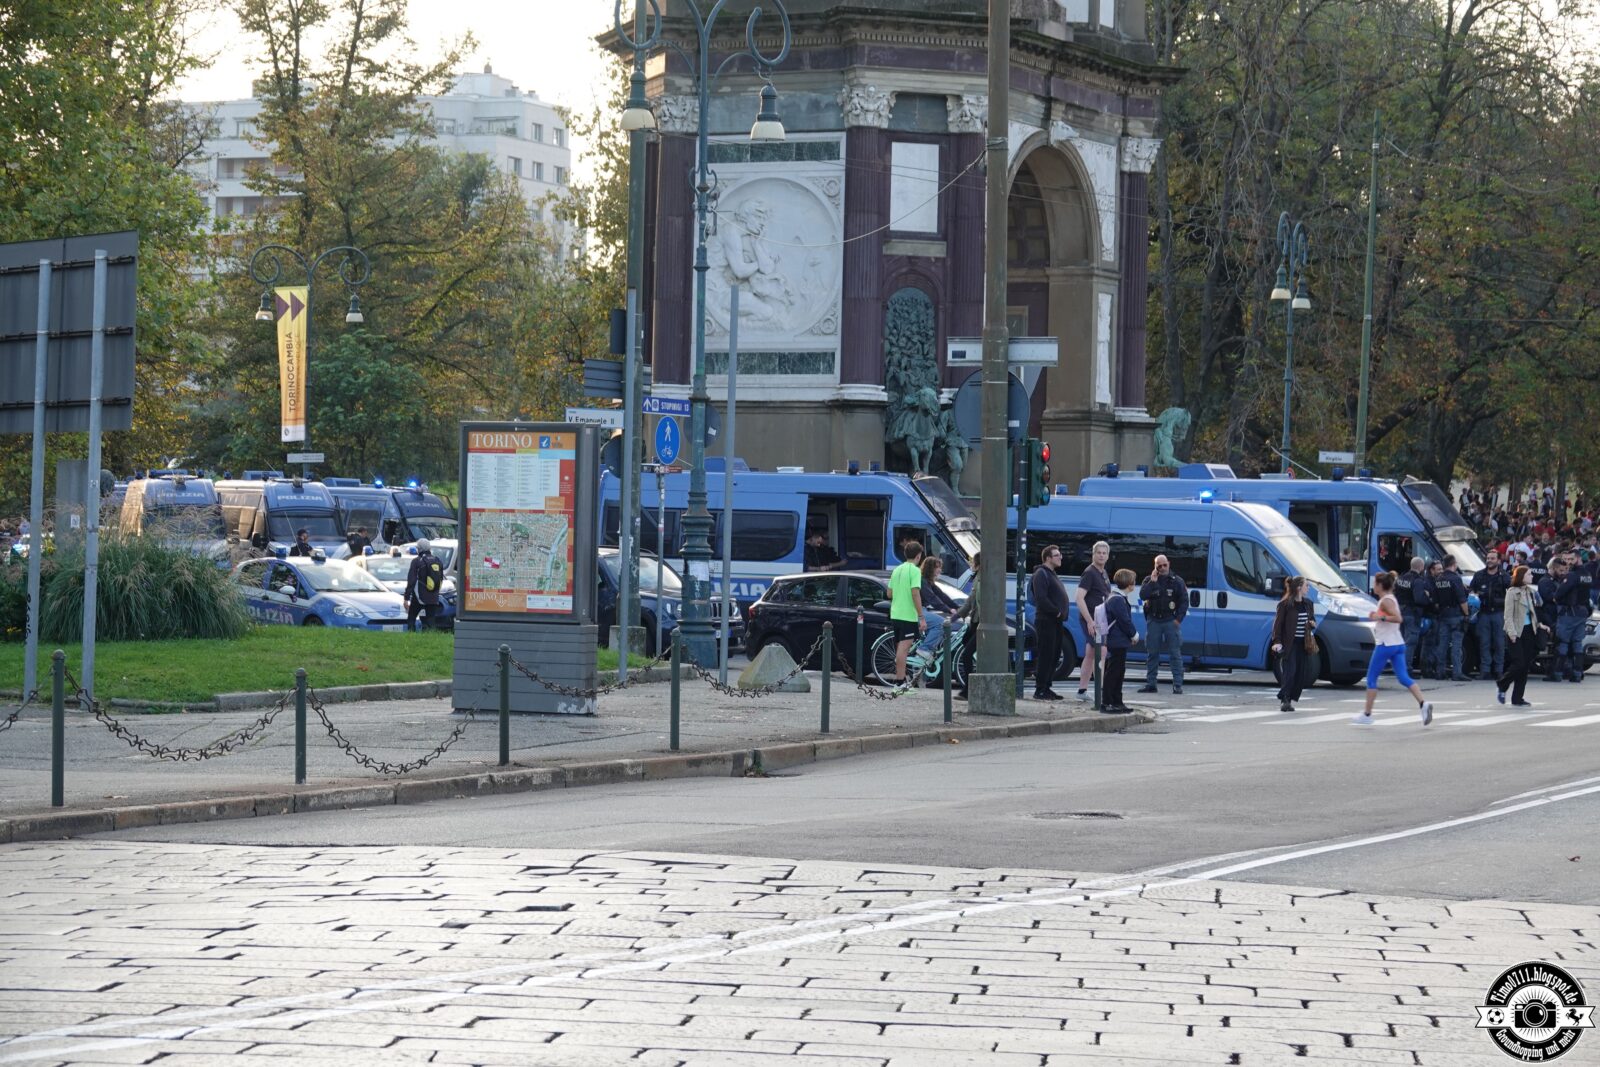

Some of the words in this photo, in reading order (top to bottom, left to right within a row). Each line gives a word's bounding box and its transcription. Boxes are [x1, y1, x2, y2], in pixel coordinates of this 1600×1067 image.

[285, 332, 296, 412] TORINOCAMBIA
[472, 433, 532, 448] TORINO
[246, 605, 295, 624] OLIZIA
